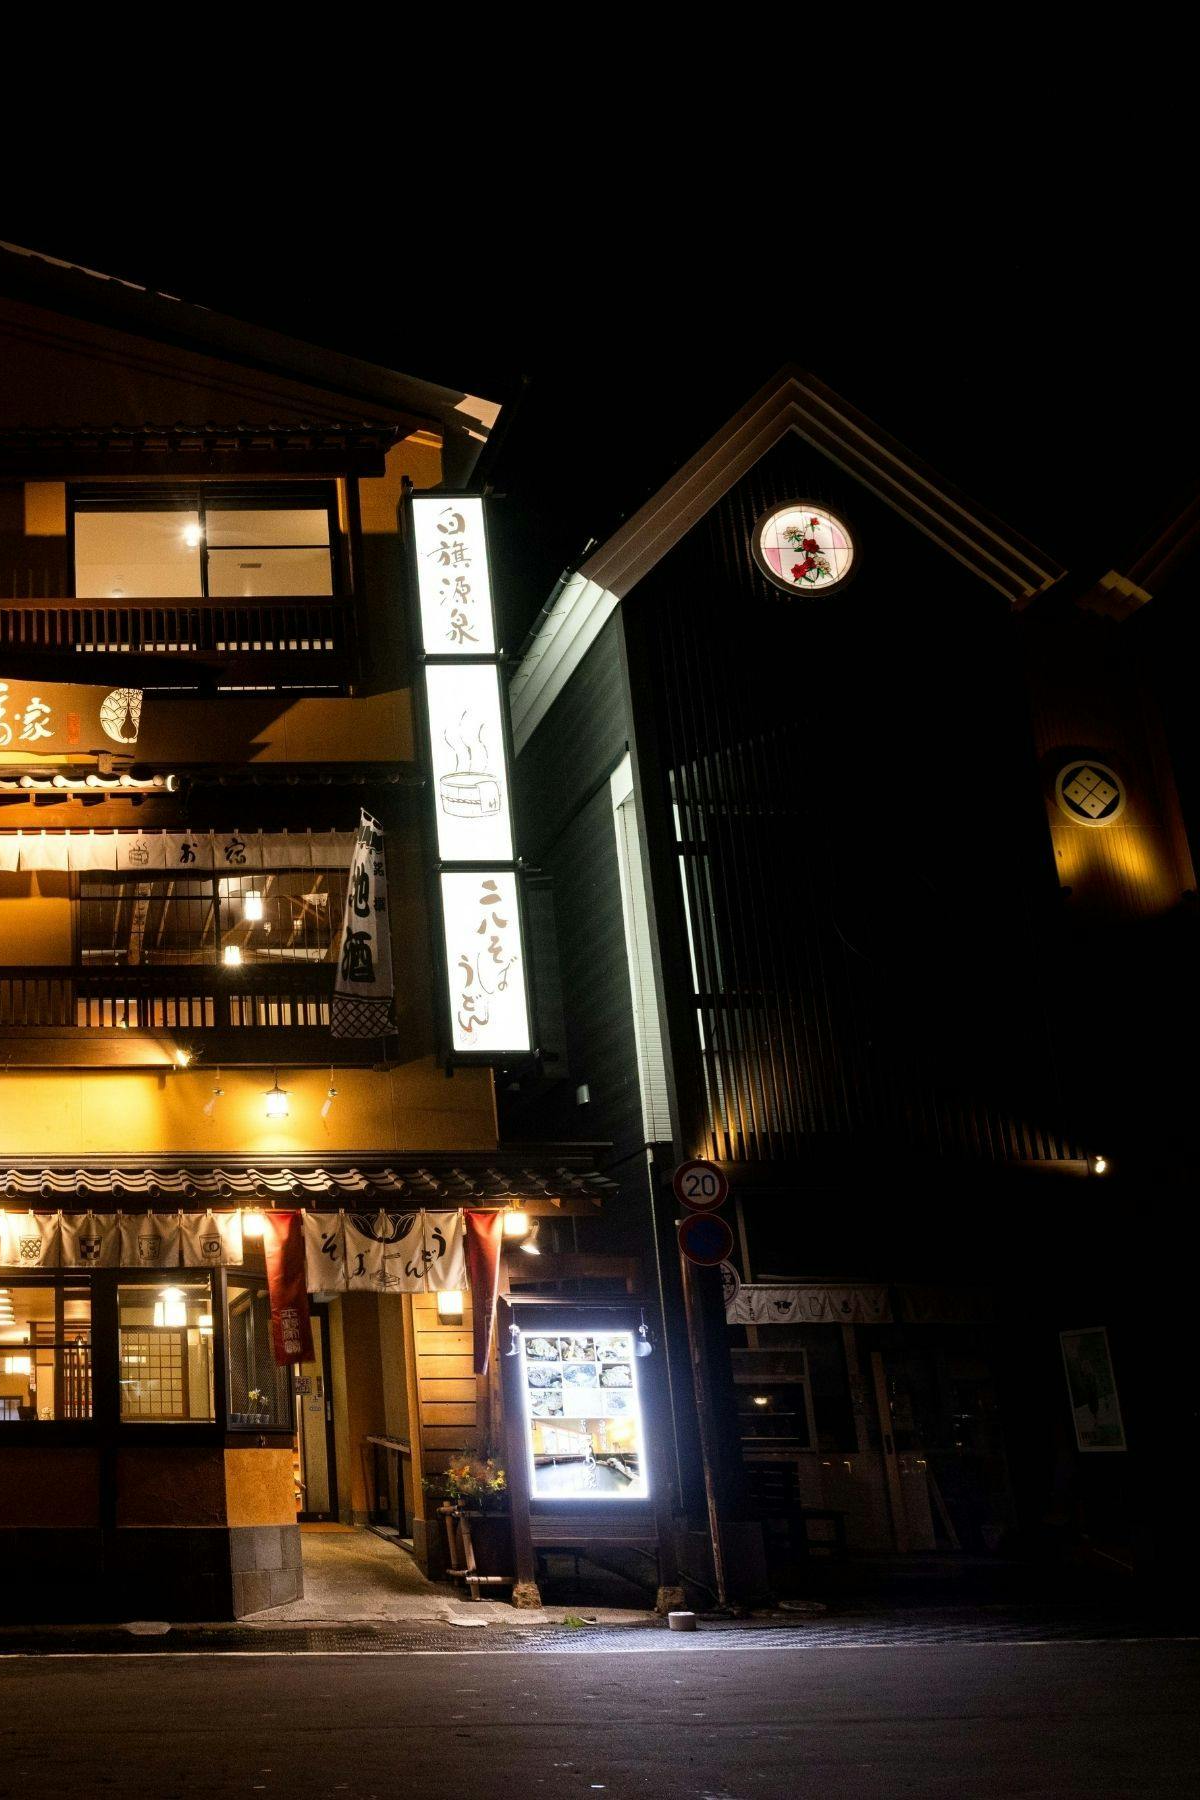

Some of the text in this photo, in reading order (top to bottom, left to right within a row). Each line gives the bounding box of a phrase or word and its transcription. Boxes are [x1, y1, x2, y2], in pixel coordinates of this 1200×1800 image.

[420, 507, 480, 645] 白旗源泉
[685, 1174, 716, 1197] 20
